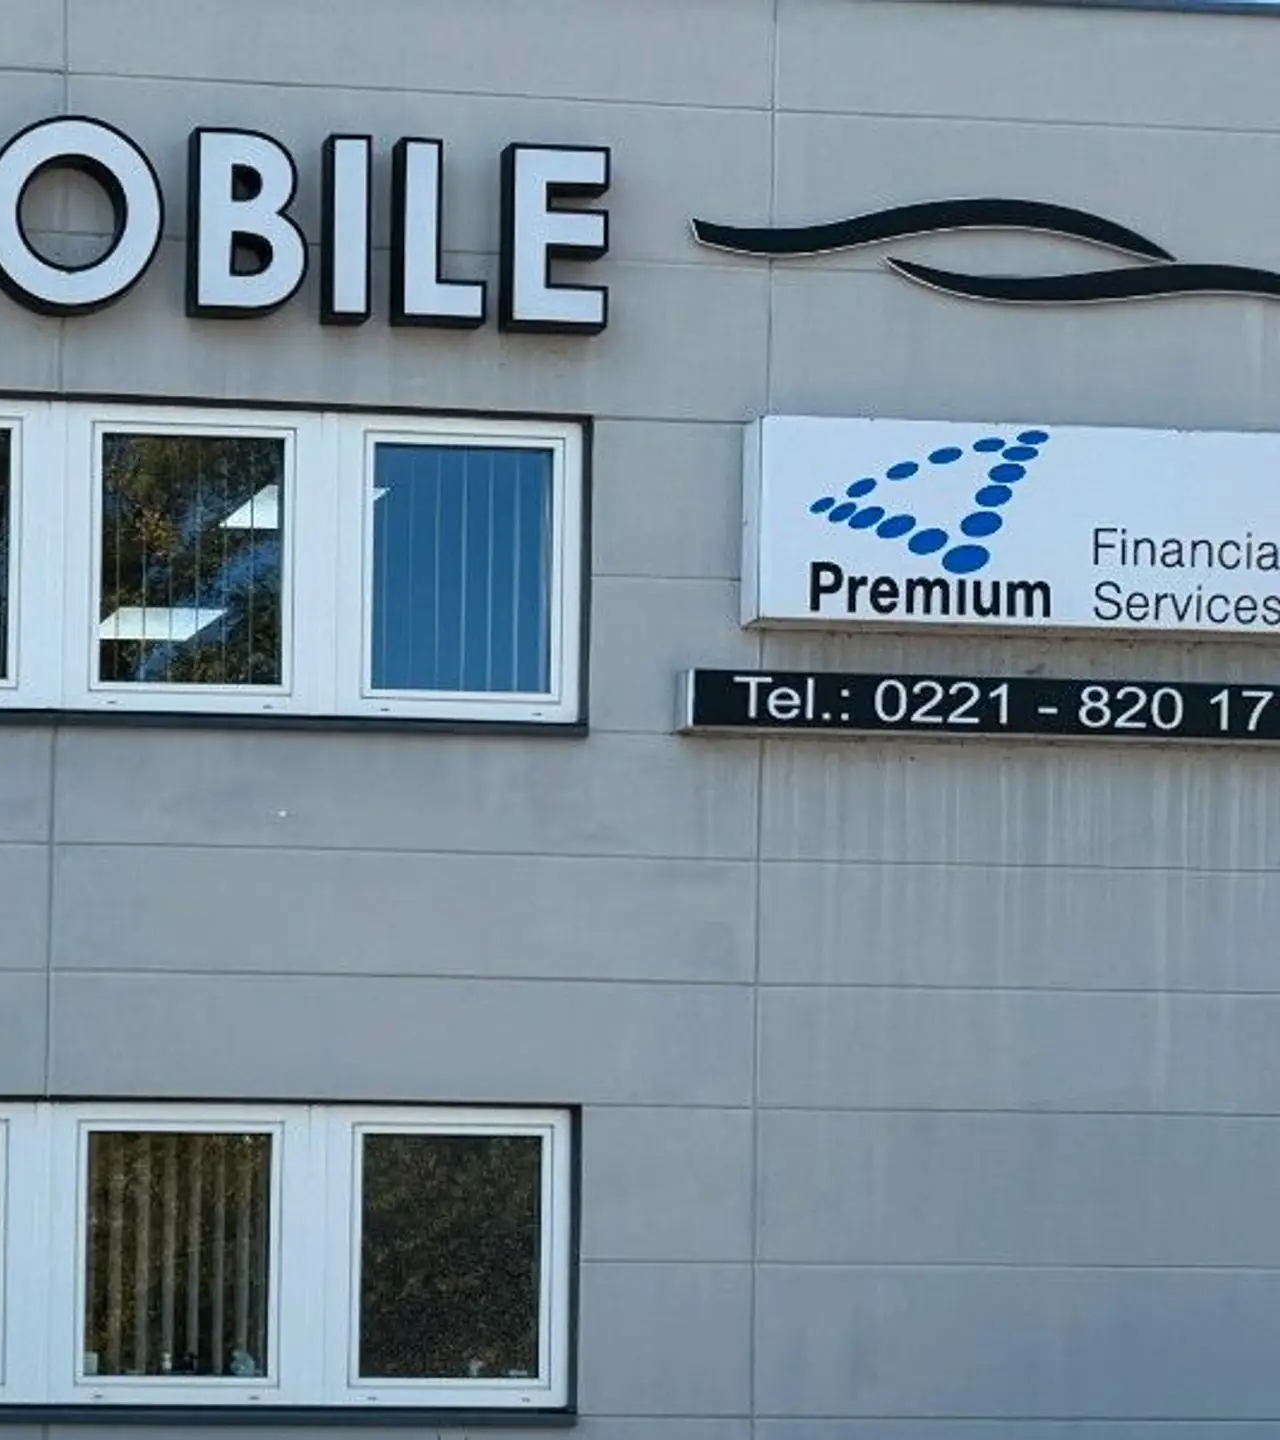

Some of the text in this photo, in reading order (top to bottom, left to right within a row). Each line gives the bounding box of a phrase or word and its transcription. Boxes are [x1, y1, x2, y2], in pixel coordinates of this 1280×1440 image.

[1092, 527, 1280, 571] Financia
[809, 561, 1052, 618] Premium
[1093, 580, 1280, 626] Services
[734, 675, 851, 722] Tel.:
[874, 679, 1010, 727] 0221
[1078, 686, 1183, 730] 820
[1210, 688, 1274, 732] 17
